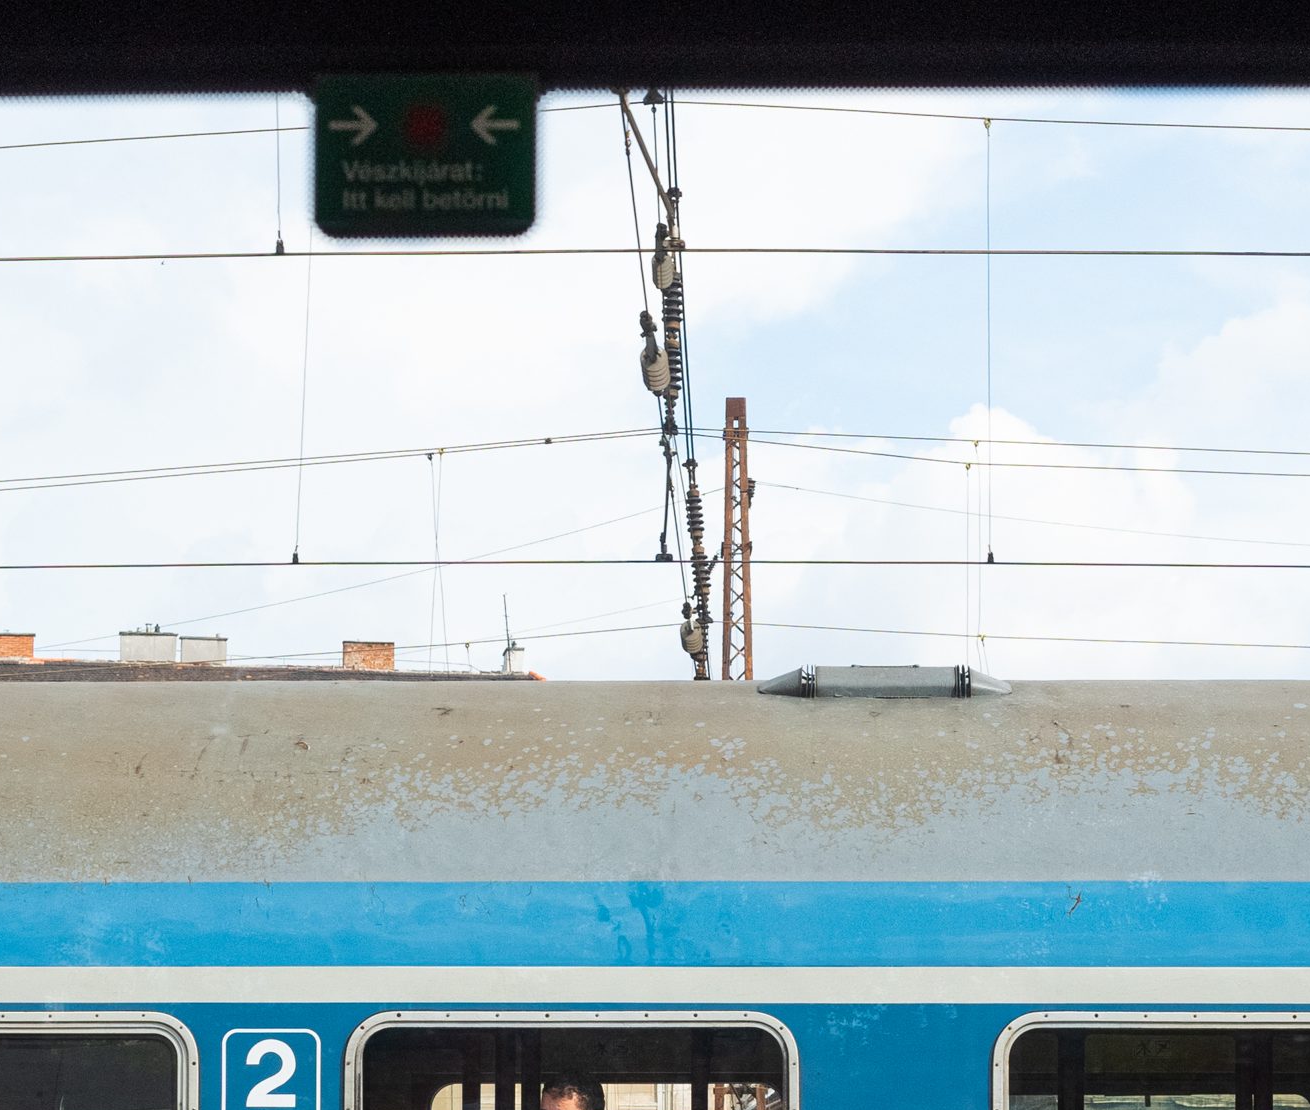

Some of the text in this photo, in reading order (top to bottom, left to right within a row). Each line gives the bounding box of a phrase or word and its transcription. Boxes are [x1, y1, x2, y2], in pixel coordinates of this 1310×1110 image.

[342, 190, 367, 210] Itt
[374, 189, 417, 210] kell
[245, 1038, 297, 1108] 2
